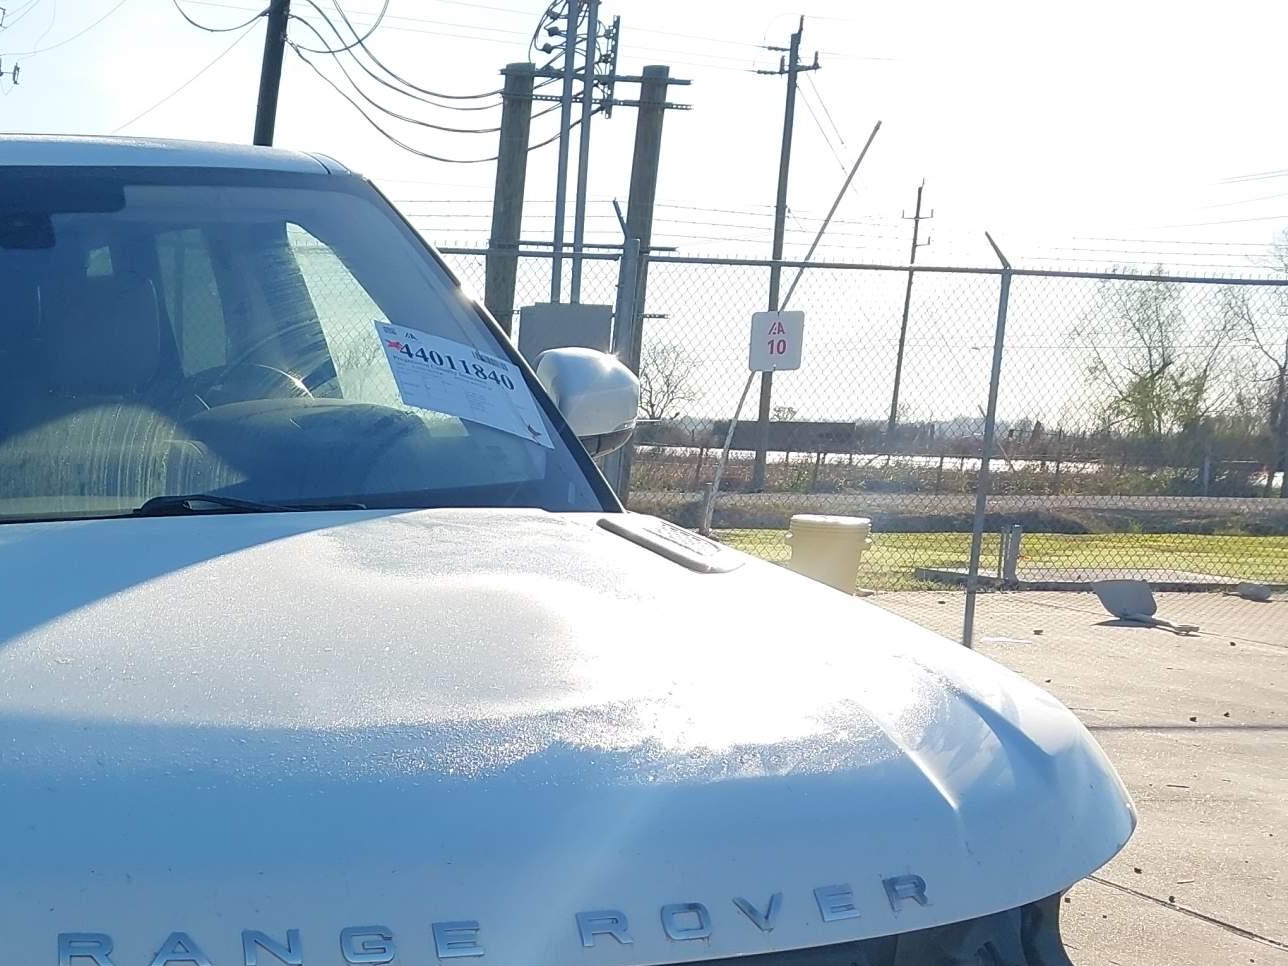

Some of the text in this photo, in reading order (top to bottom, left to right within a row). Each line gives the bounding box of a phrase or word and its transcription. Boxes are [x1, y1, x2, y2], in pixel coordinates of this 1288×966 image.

[399, 342, 515, 391] 44011840
[767, 339, 786, 355] 10
[575, 873, 928, 948] ROVER
